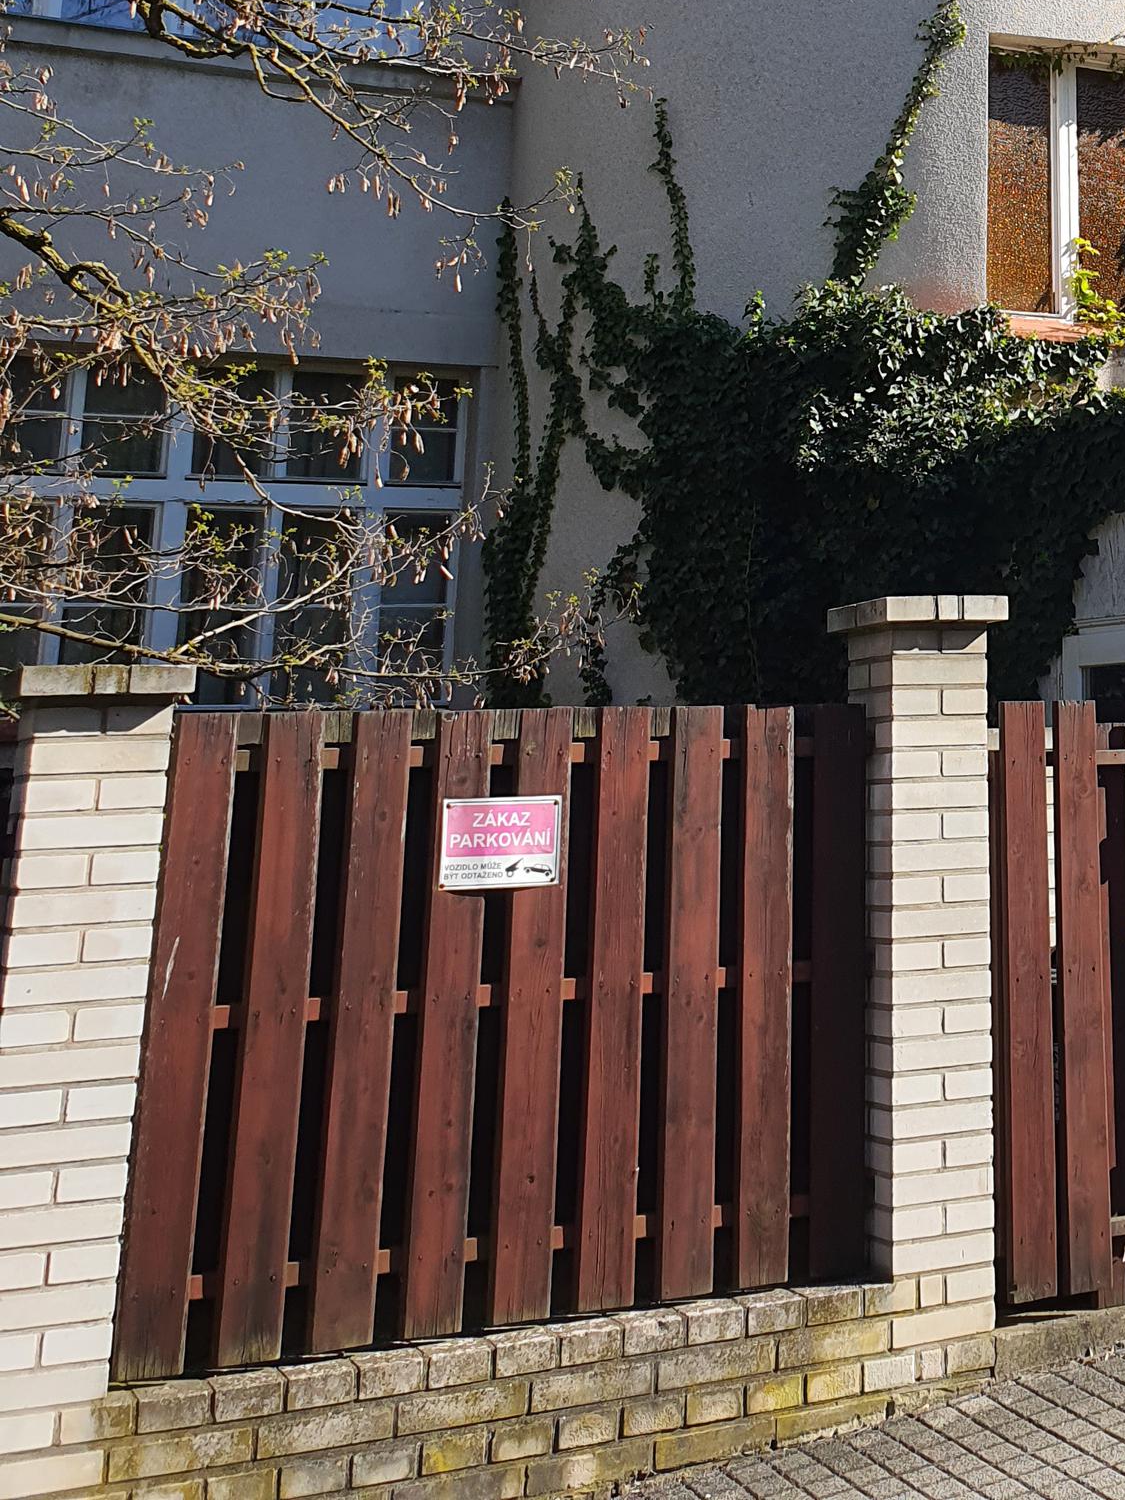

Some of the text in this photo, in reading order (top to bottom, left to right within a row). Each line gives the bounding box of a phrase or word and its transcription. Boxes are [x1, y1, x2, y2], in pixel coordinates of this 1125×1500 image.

[472, 809, 531, 828] ZÁKAZ
[449, 828, 551, 849] PARKOVÁNÍ
[444, 862, 502, 871] VOZIDLO MŮŽE
[443, 870, 504, 881] BÝT ODTAŽENO
